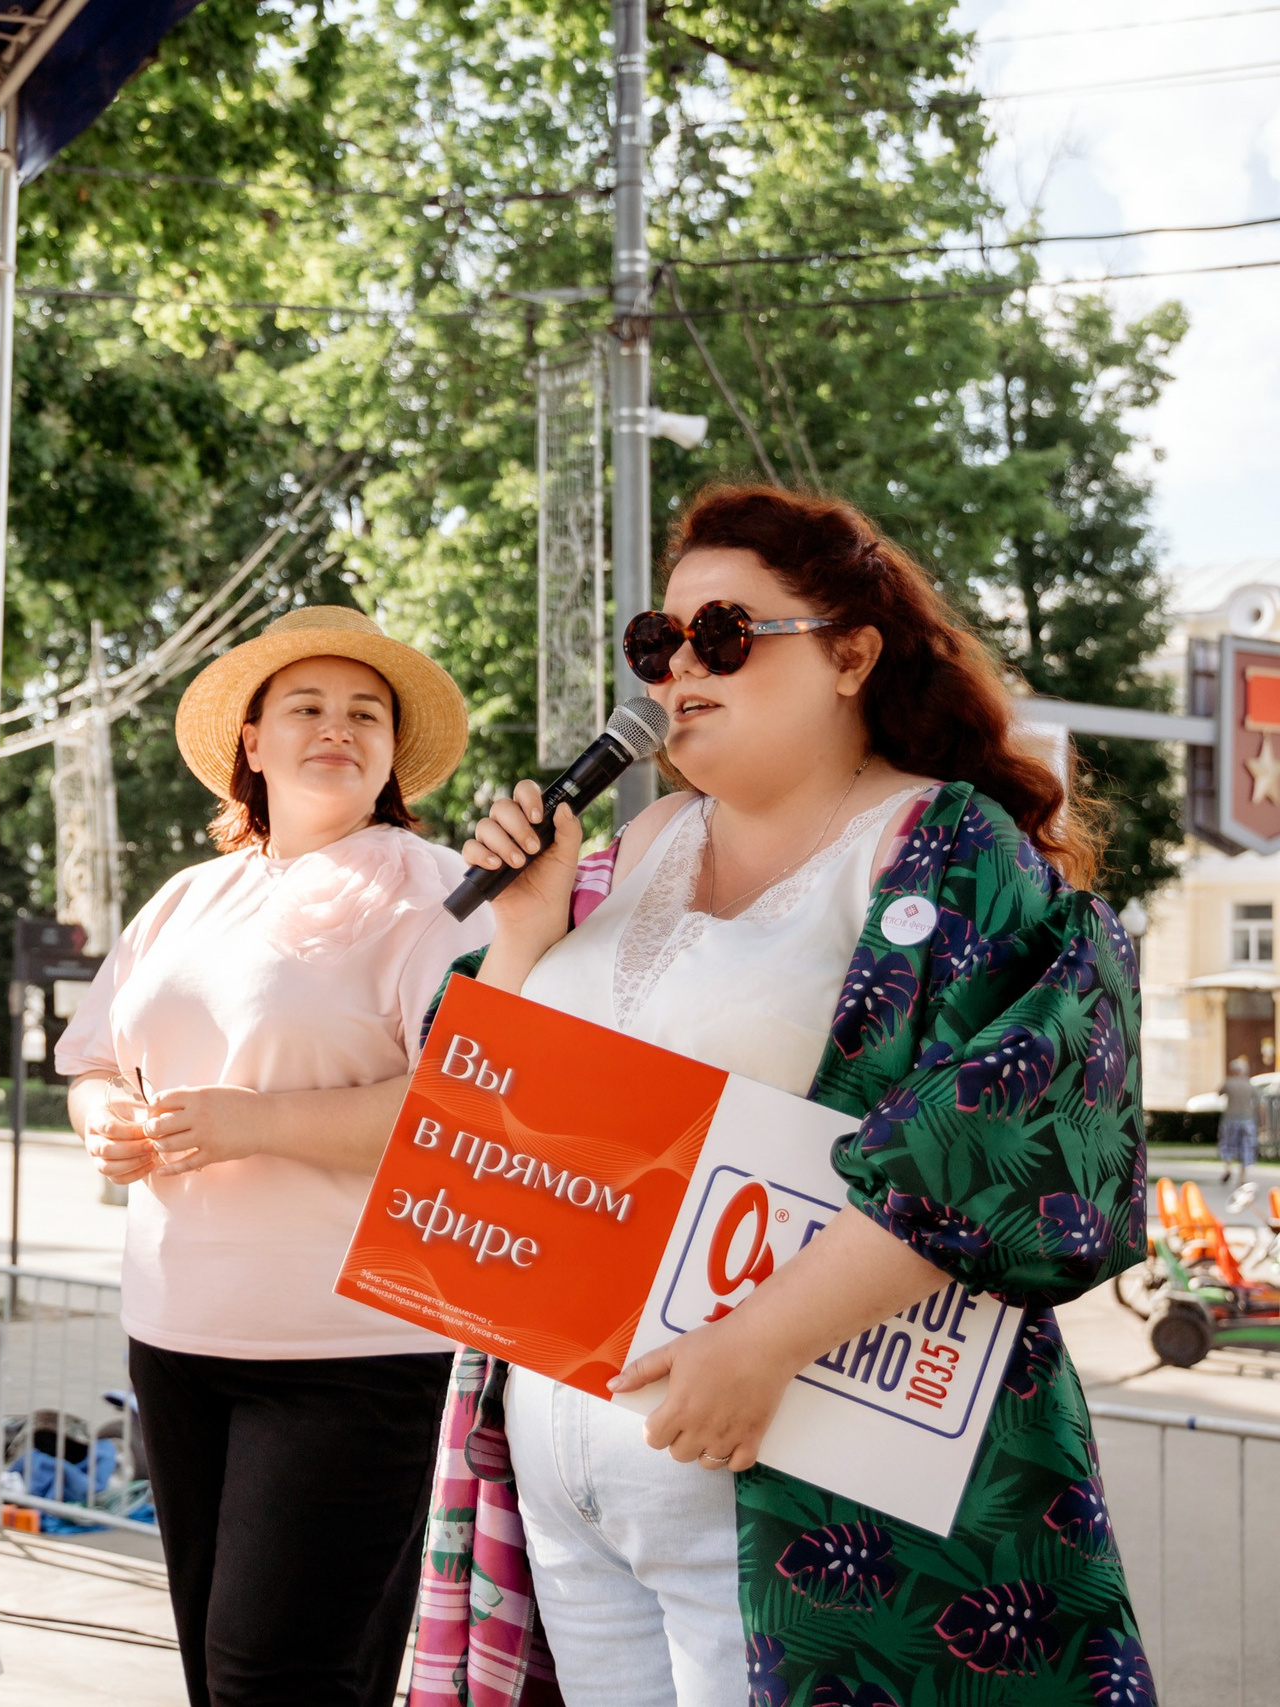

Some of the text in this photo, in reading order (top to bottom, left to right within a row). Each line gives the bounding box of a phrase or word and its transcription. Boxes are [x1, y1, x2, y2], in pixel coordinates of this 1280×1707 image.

[440, 1034, 513, 1095] Вы
[413, 1117, 631, 1222] в прямом
[386, 1188, 539, 1267] эфире
[356, 1280, 421, 1310] организаторами
[421, 1305, 464, 1328] фестиваля
[360, 1268, 382, 1283] Эфир
[382, 1278, 445, 1308] осуществляется
[444, 1303, 487, 1324] совместно
[905, 1338, 960, 1410] 103.5
